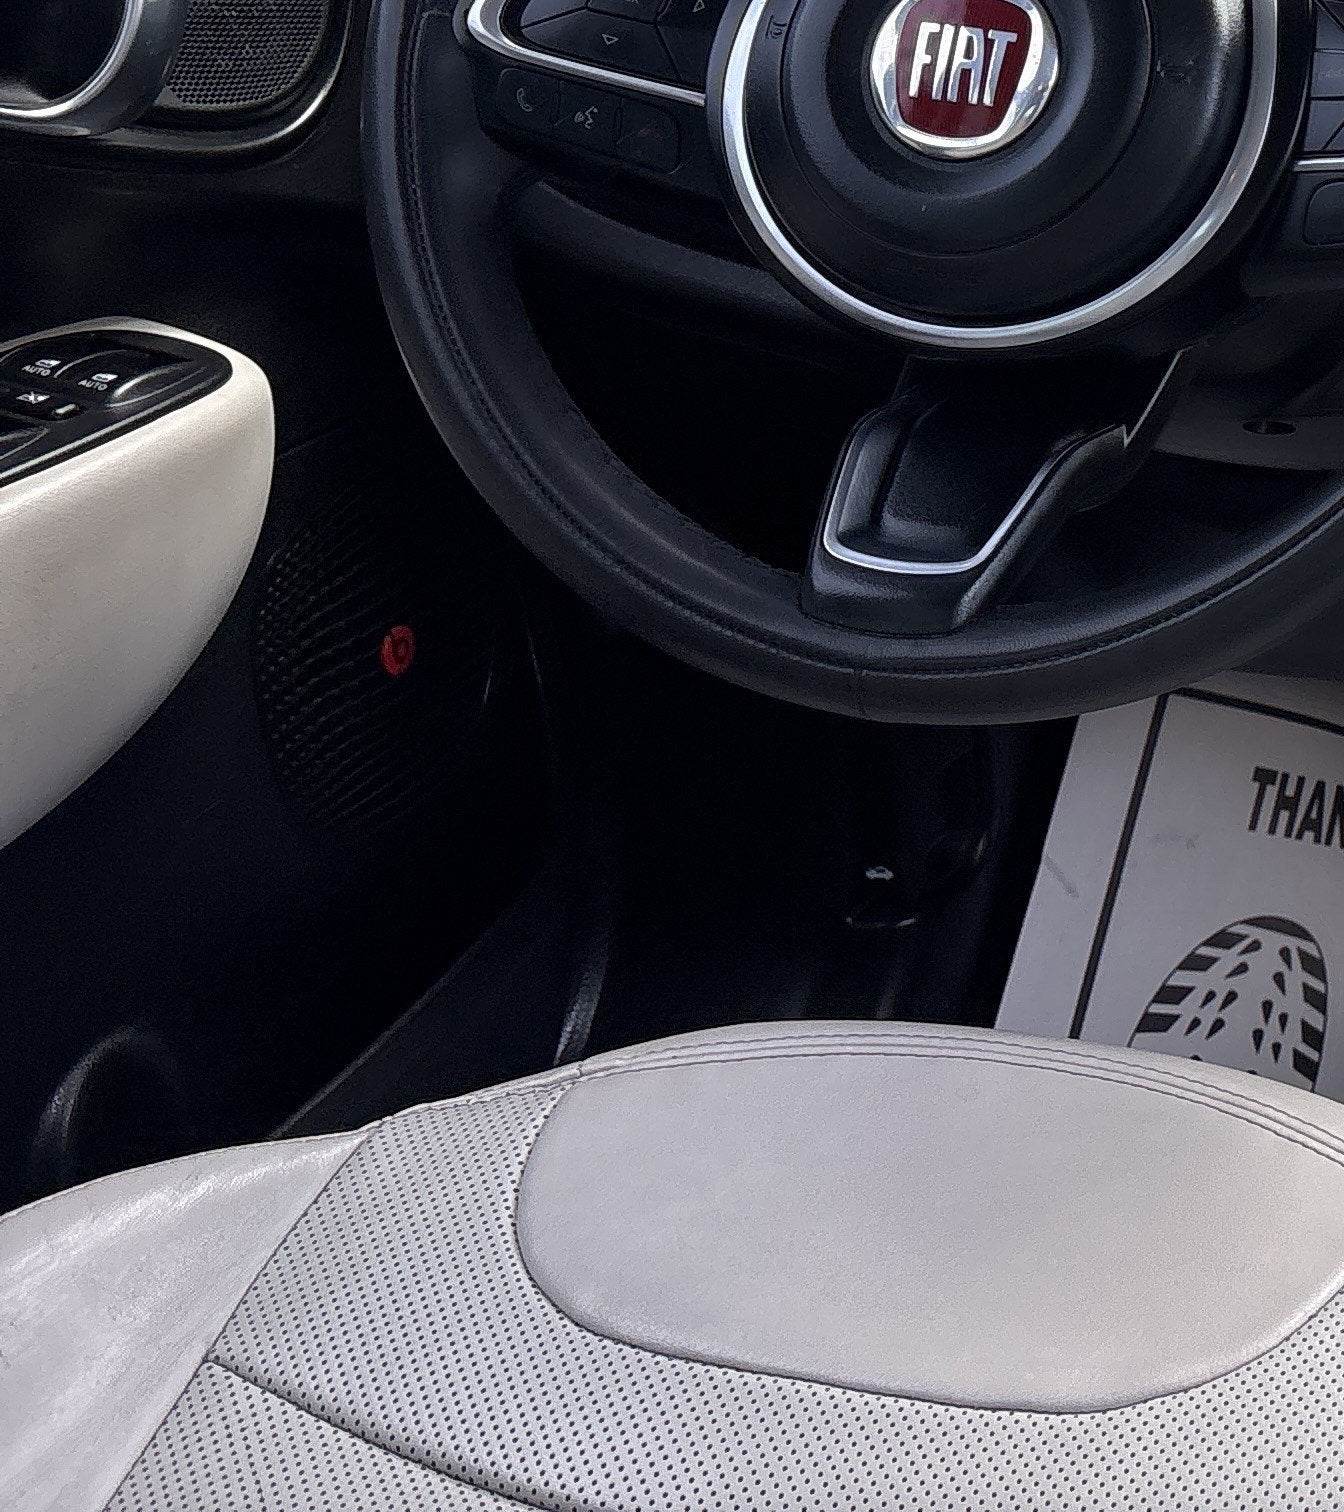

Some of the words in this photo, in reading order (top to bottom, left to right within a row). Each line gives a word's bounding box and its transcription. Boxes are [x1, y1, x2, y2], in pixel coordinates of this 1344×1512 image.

[908, 21, 1018, 107] FIAT
[21, 364, 52, 377] AUTO
[77, 378, 109, 391] AUTO
